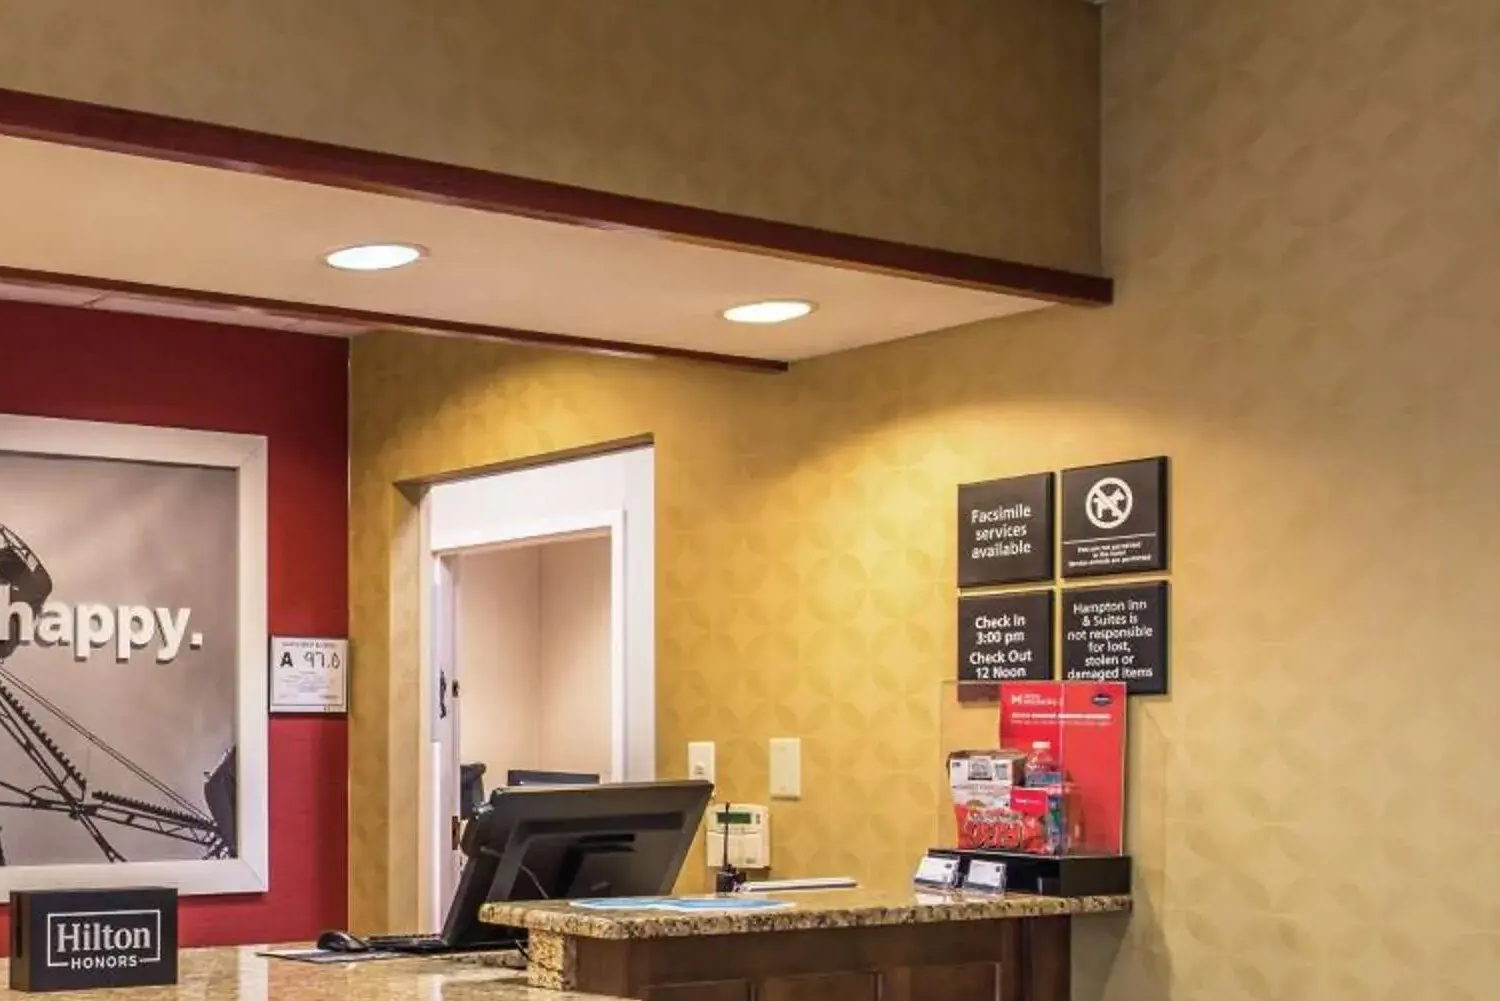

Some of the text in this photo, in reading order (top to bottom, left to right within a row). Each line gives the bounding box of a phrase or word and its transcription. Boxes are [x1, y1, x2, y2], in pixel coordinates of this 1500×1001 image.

[971, 503, 1032, 524] Facsimile
[975, 523, 1028, 541] services
[971, 539, 1032, 559] available
[1073, 600, 1147, 615] Hampton Inn
[975, 614, 1011, 629] Check
[1082, 612, 1138, 627] & Suites is
[976, 630, 1025, 647] 3:00 pm
[1067, 625, 1153, 641] not responsible
[1088, 642, 1104, 653] for
[280, 651, 294, 668] A
[969, 648, 1033, 665] Check Out
[1085, 653, 1134, 667] stolen or
[976, 666, 1027, 679] 12 Noon
[1067, 667, 1119, 681] damaged
[57, 922, 151, 953] Hilton
[71, 955, 138, 970] HONORS
